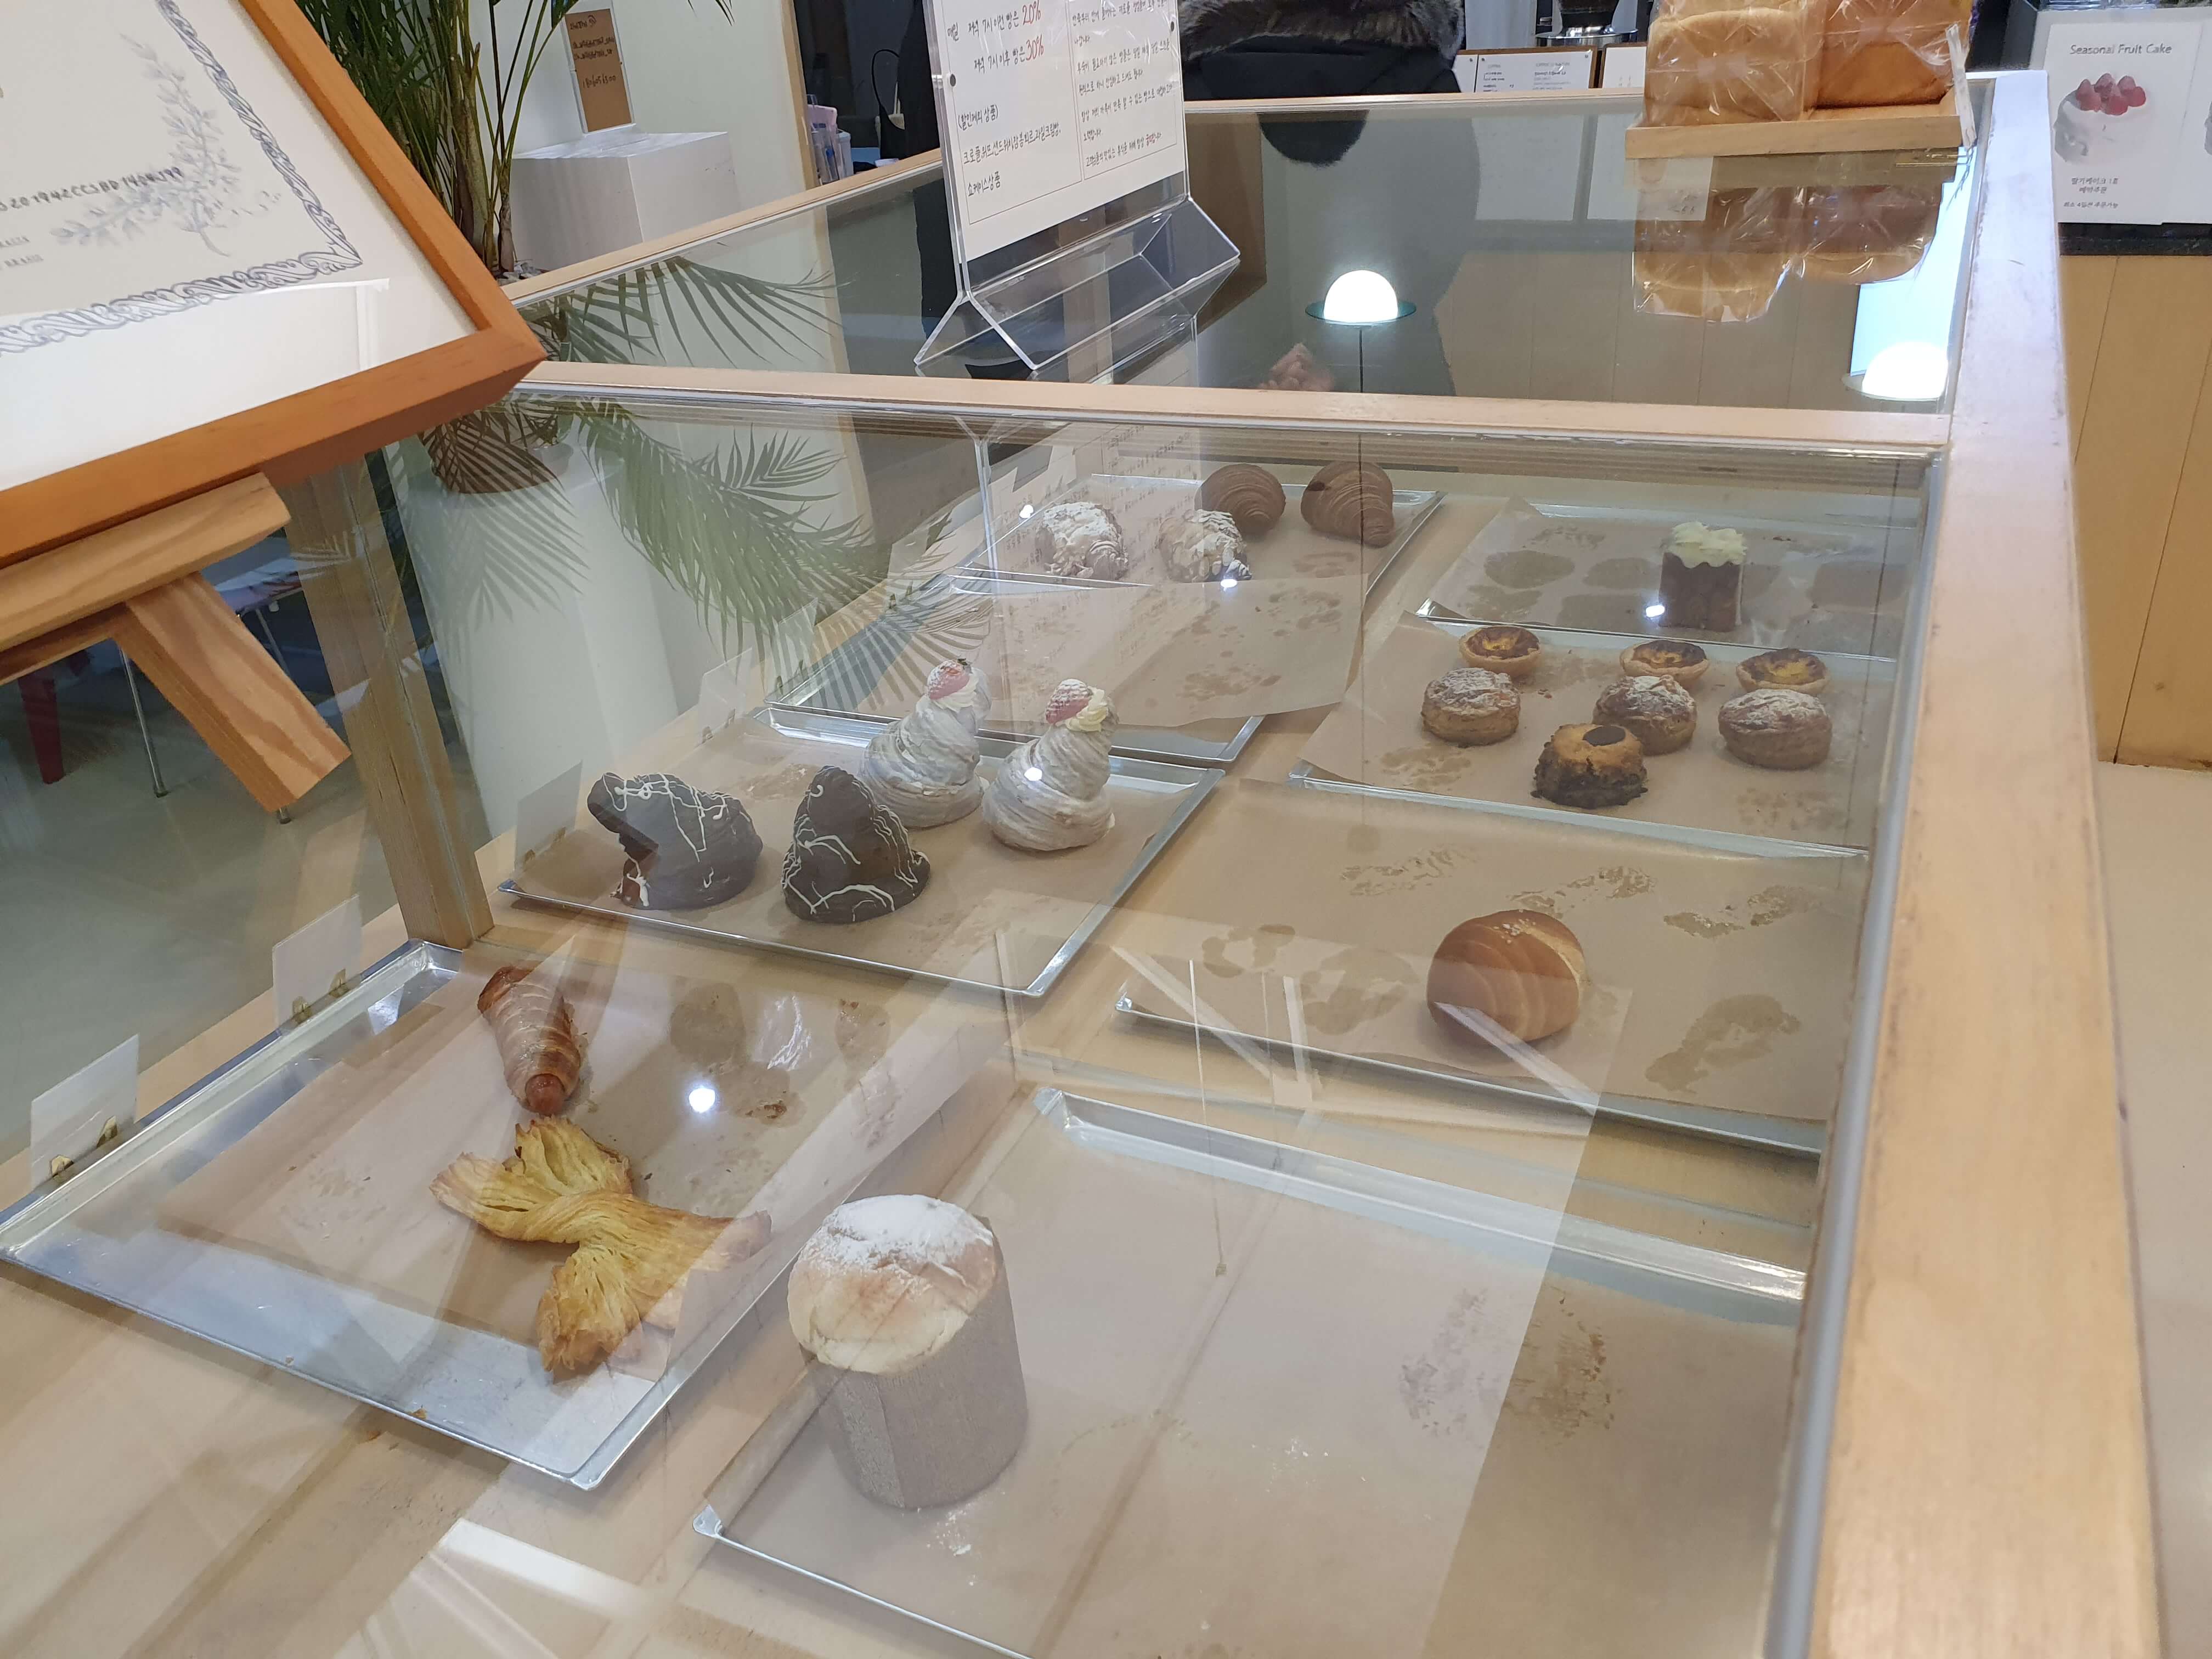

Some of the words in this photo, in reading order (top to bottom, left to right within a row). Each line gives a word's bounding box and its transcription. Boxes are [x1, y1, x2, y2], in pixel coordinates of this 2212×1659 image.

[1023, 0, 1041, 25] 20%
[1026, 35, 1044, 61] 30%
[2070, 44, 2114, 55] Seasonal
[2118, 44, 2142, 54] Fruit
[2146, 43, 2172, 54] Cake
